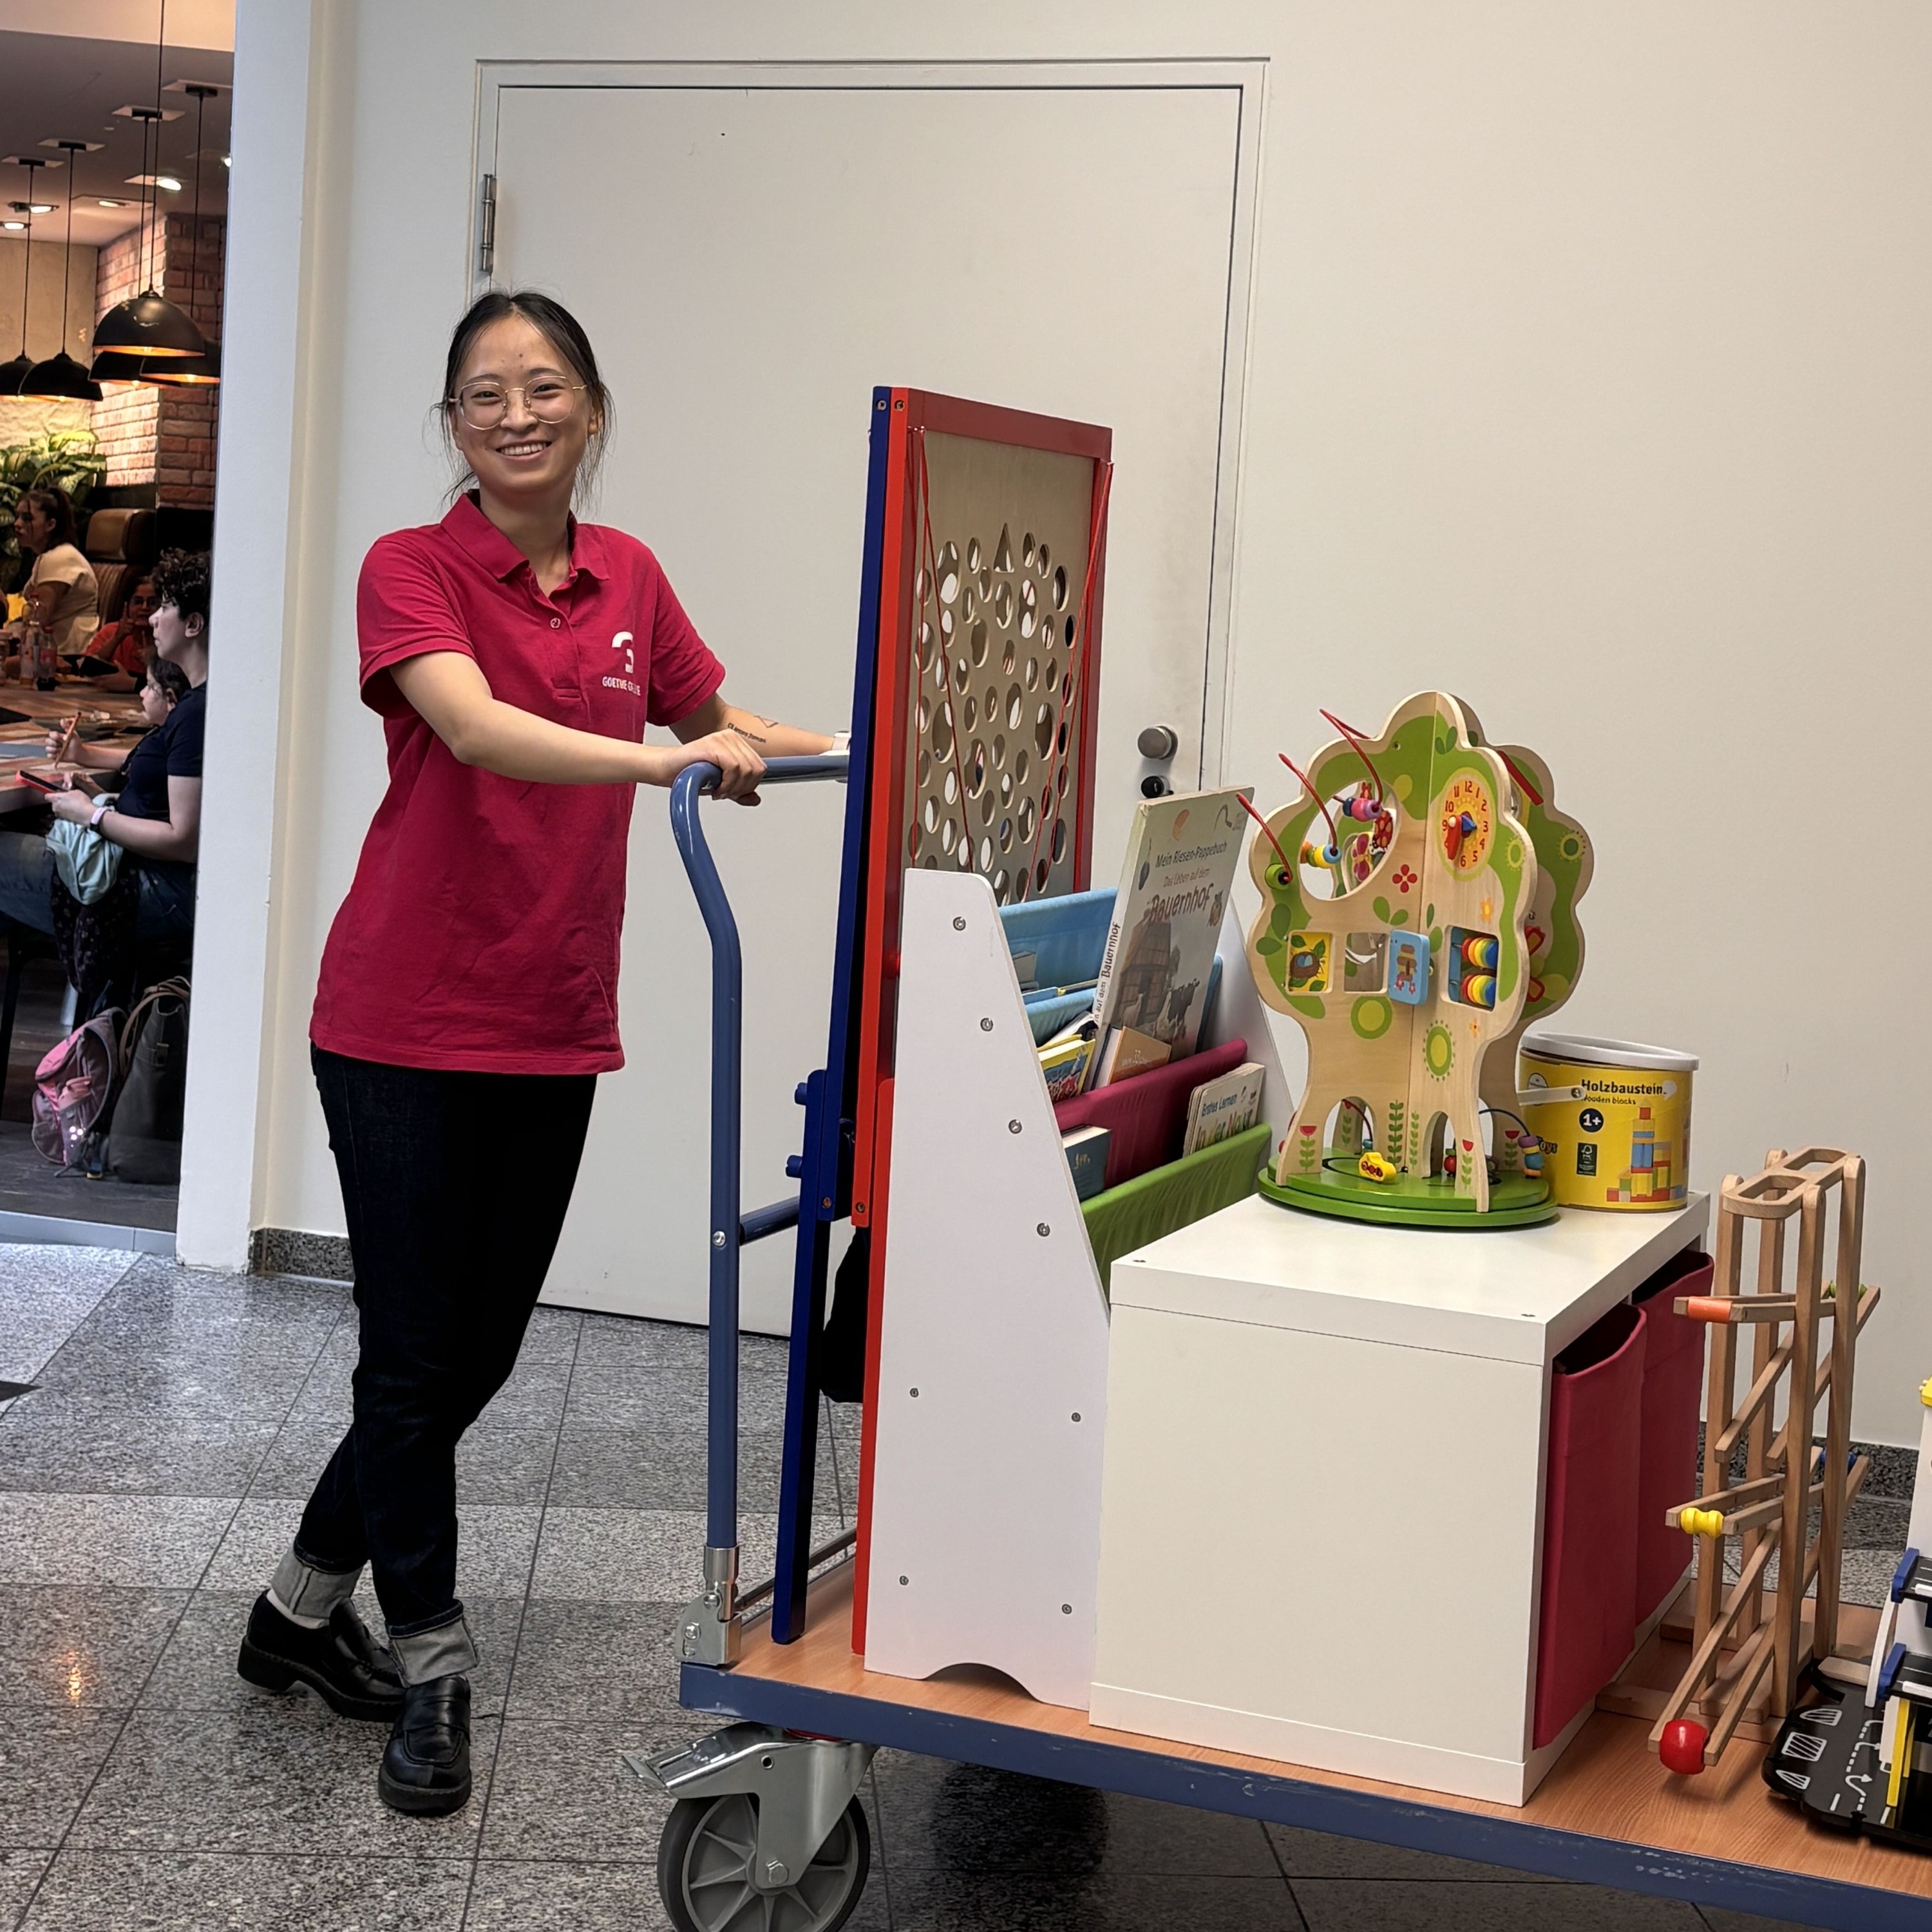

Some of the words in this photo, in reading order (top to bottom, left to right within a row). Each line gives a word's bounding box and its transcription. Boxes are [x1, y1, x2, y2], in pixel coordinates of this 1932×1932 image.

[1454, 784, 1459, 797] 11
[1464, 781, 1473, 793] 12
[1475, 787, 1480, 799] 1
[1445, 800, 1454, 813] 10
[1481, 799, 1487, 811] 2
[1442, 819, 1448, 831] 9
[1482, 821, 1488, 833] 3
[1479, 838, 1485, 850] 4
[1155, 851, 1171, 868] Mein
[1461, 855, 1466, 867] 6
[1472, 850, 1478, 862] 5
[1150, 883, 1214, 922] Bauernhof
[1101, 921, 1121, 978] Bauernhof
[1581, 1079, 1667, 1095] Holzbaustein
[1583, 1113, 1602, 1126] 1+
